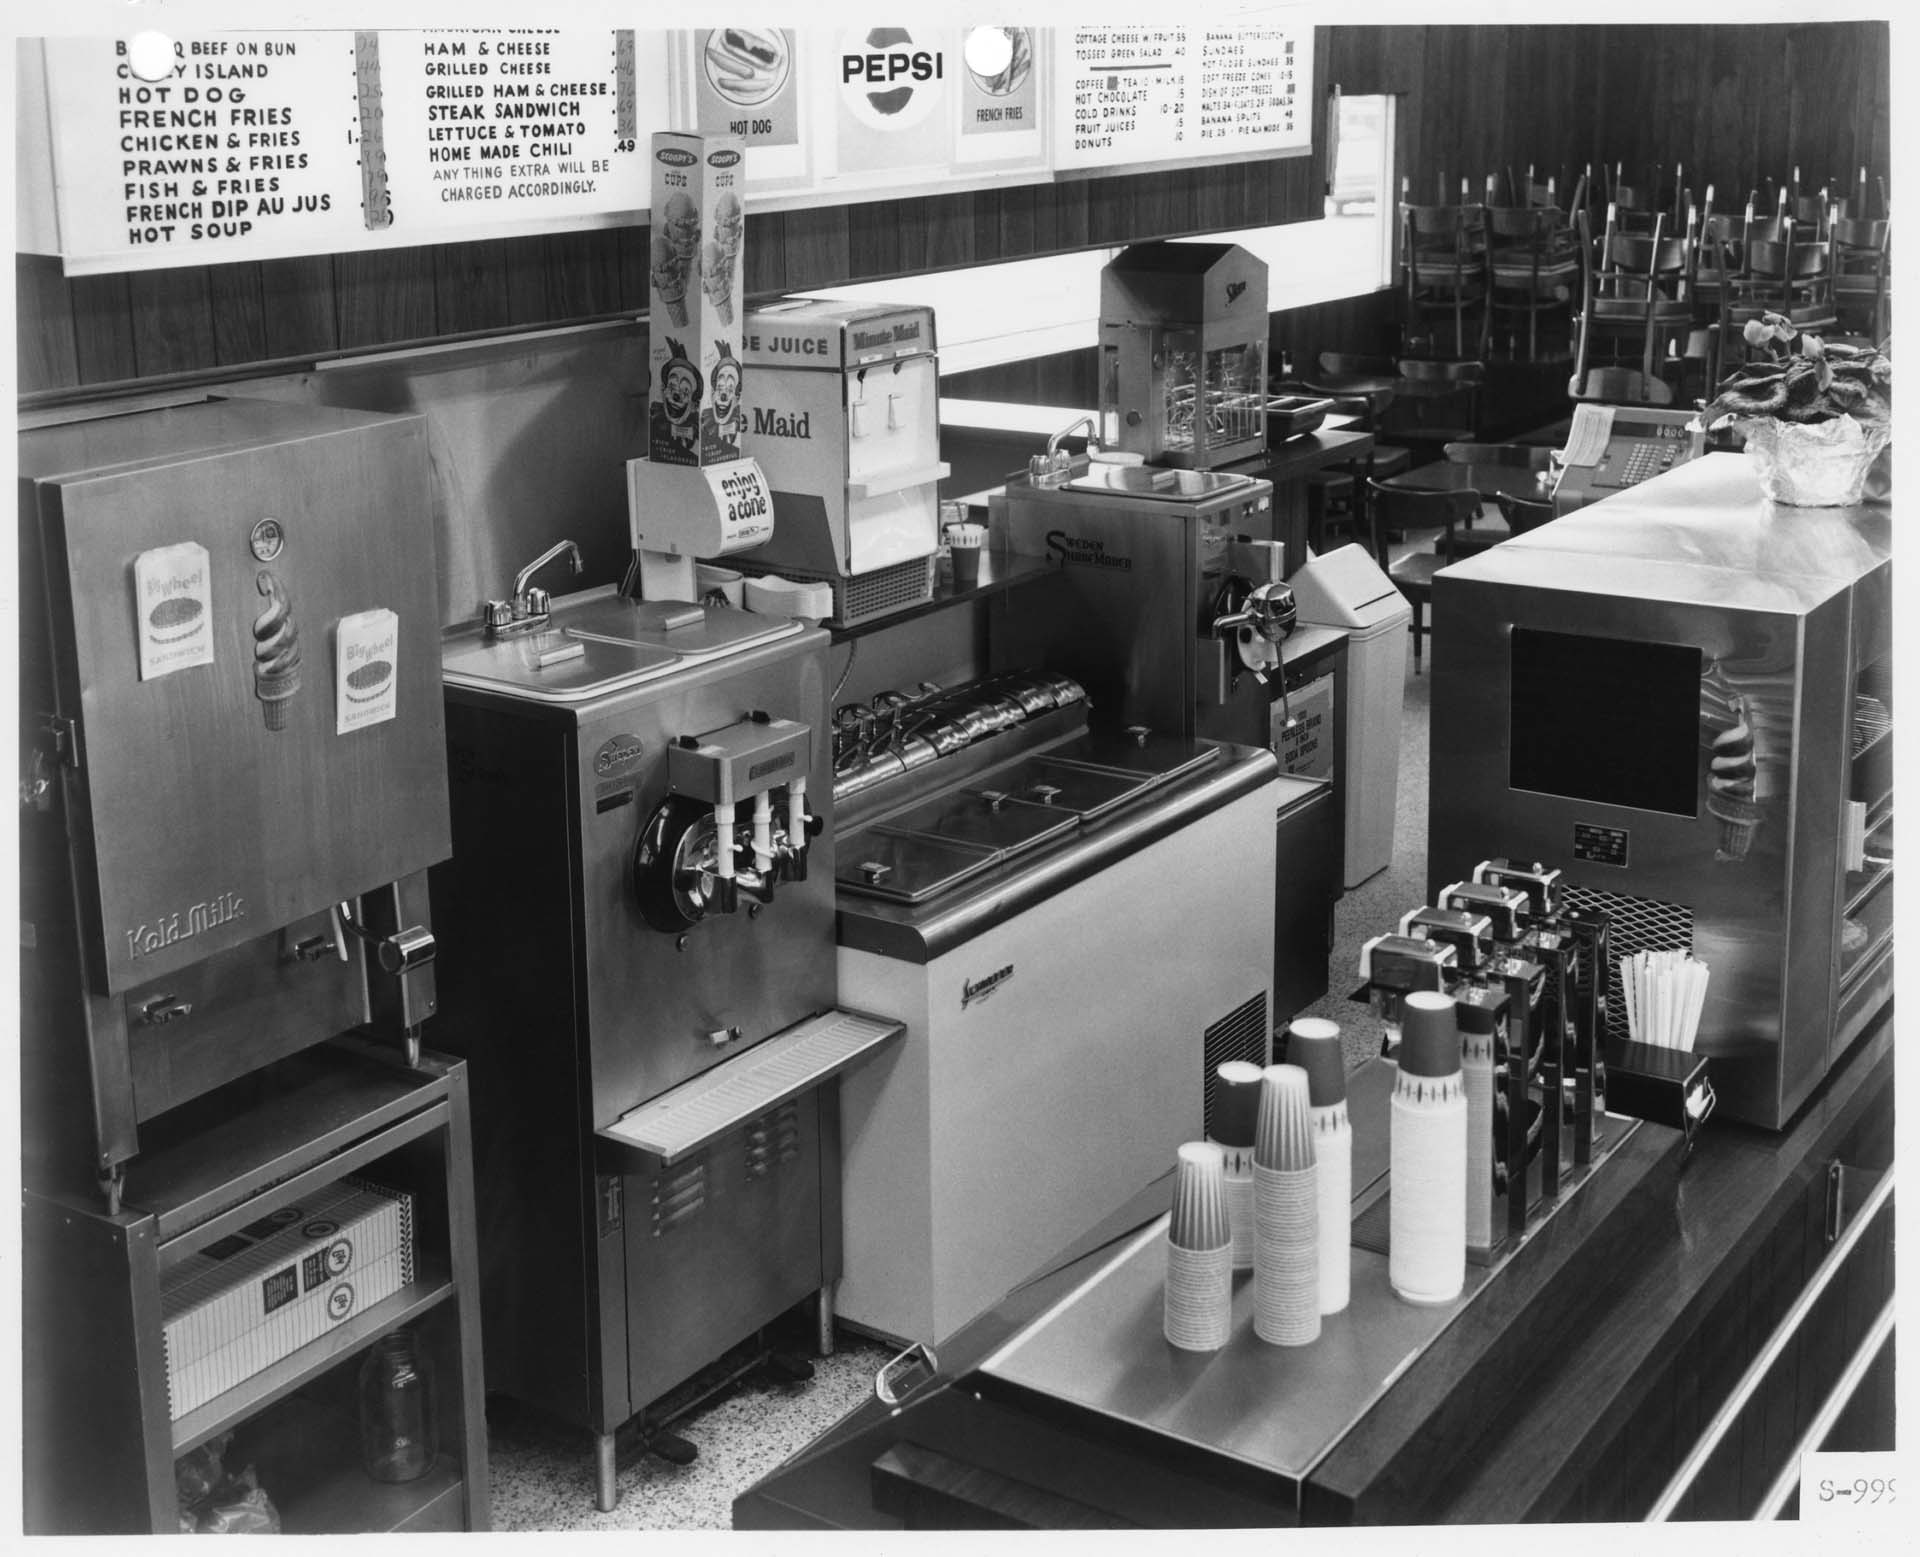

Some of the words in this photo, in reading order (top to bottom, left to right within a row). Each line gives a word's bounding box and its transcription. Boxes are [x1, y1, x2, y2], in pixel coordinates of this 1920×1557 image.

[1076, 33, 1107, 44] COTTAGE
[1111, 33, 1139, 44] CHEESE
[191, 42, 228, 56] BEEF
[236, 42, 258, 56] ON
[265, 42, 296, 56] BUN
[424, 42, 466, 56] HAM
[478, 41, 490, 56] &
[497, 42, 551, 56] CHEESE
[1076, 49, 1106, 60] TOSSED
[1111, 49, 1135, 58] GREEN
[1139, 48, 1162, 58] SALAD
[196, 64, 268, 79] ISLAND
[425, 62, 488, 76] GRILLED
[500, 62, 551, 75] CHEESE
[842, 51, 944, 84] PEPSI
[426, 85, 484, 98] GRILLED
[493, 84, 529, 98] HAM
[535, 84, 545, 96] &
[550, 83, 607, 96] CHEESE
[1075, 79, 1104, 90] COFFEE
[1123, 77, 1138, 88] TEA
[119, 87, 171, 104] HOT
[184, 87, 246, 104] DOG
[1075, 93, 1092, 105] HOT
[1097, 90, 1147, 104] CHOCOLATE
[120, 110, 217, 128] FRENCH
[231, 107, 292, 126] FRIES
[428, 105, 485, 121] STEAK
[495, 101, 580, 119] SANDWICH
[976, 108, 1003, 123] FRENCH
[1005, 106, 1023, 121] FRIES
[1075, 108, 1098, 120] COLD
[1103, 105, 1136, 118] DRINKS
[730, 120, 748, 136] HOT
[752, 119, 772, 135] DOG
[1075, 123, 1101, 135] FRUIT
[1104, 120, 1136, 133] JUICES
[1201, 115, 1232, 125] BANANA
[428, 125, 497, 141] LETTUCE
[504, 125, 515, 138] &
[520, 122, 586, 137] TOMATO
[121, 134, 218, 152] CHICKEN
[226, 133, 241, 149] &
[249, 130, 300, 148] FRIES
[1075, 136, 1112, 150] DONUTS
[429, 147, 471, 162] HOME
[480, 145, 520, 160] MADE
[530, 143, 572, 158] CHILI
[614, 140, 635, 153] .49
[124, 157, 217, 176] PRAWNS
[225, 157, 241, 173] &
[250, 153, 308, 171] FRIES
[510, 163, 551, 177] EXTRA
[558, 161, 585, 174] WILL
[592, 160, 609, 173] BE
[665, 172, 688, 187] CUPS
[716, 174, 734, 188] CUPS
[125, 182, 178, 200] FISH
[192, 180, 207, 196] &
[218, 177, 280, 195] FRIES
[441, 184, 502, 203] CHARGED
[508, 180, 596, 200] ACCORDINGLY.
[127, 201, 203, 222] FRENCH
[212, 199, 249, 218] DIP
[257, 197, 284, 216] AU
[292, 194, 331, 212] JUS
[129, 226, 175, 244] HOT
[191, 221, 252, 240] SOUP
[768, 337, 828, 355] JUICE
[753, 407, 811, 440] Maid
[721, 471, 761, 500] enjoy
[728, 502, 737, 521] a
[738, 496, 767, 519] cone
